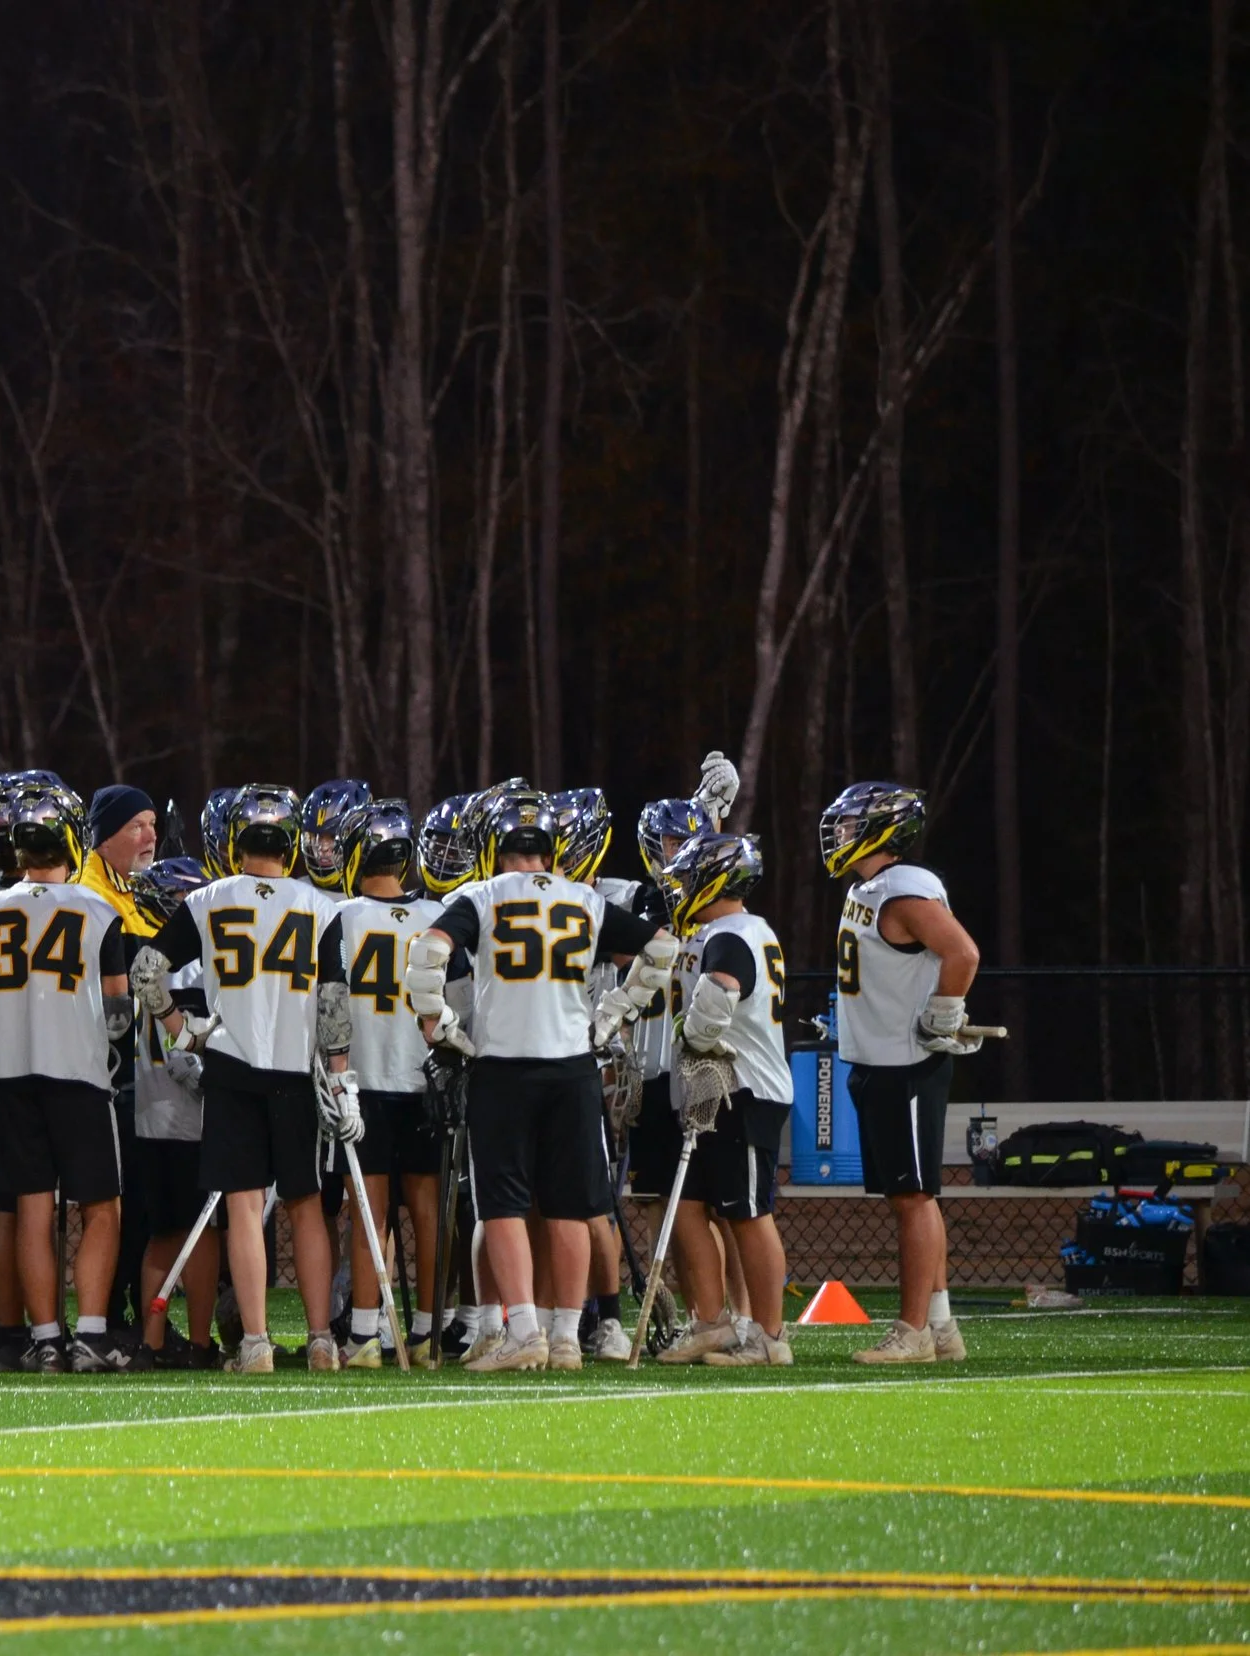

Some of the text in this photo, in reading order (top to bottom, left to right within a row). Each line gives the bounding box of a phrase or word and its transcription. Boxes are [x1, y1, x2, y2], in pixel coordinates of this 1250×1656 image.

[208, 906, 318, 994] 54
[350, 929, 422, 1016] 4
[492, 900, 592, 983] 52
[818, 1057, 831, 1146] POWERADE
